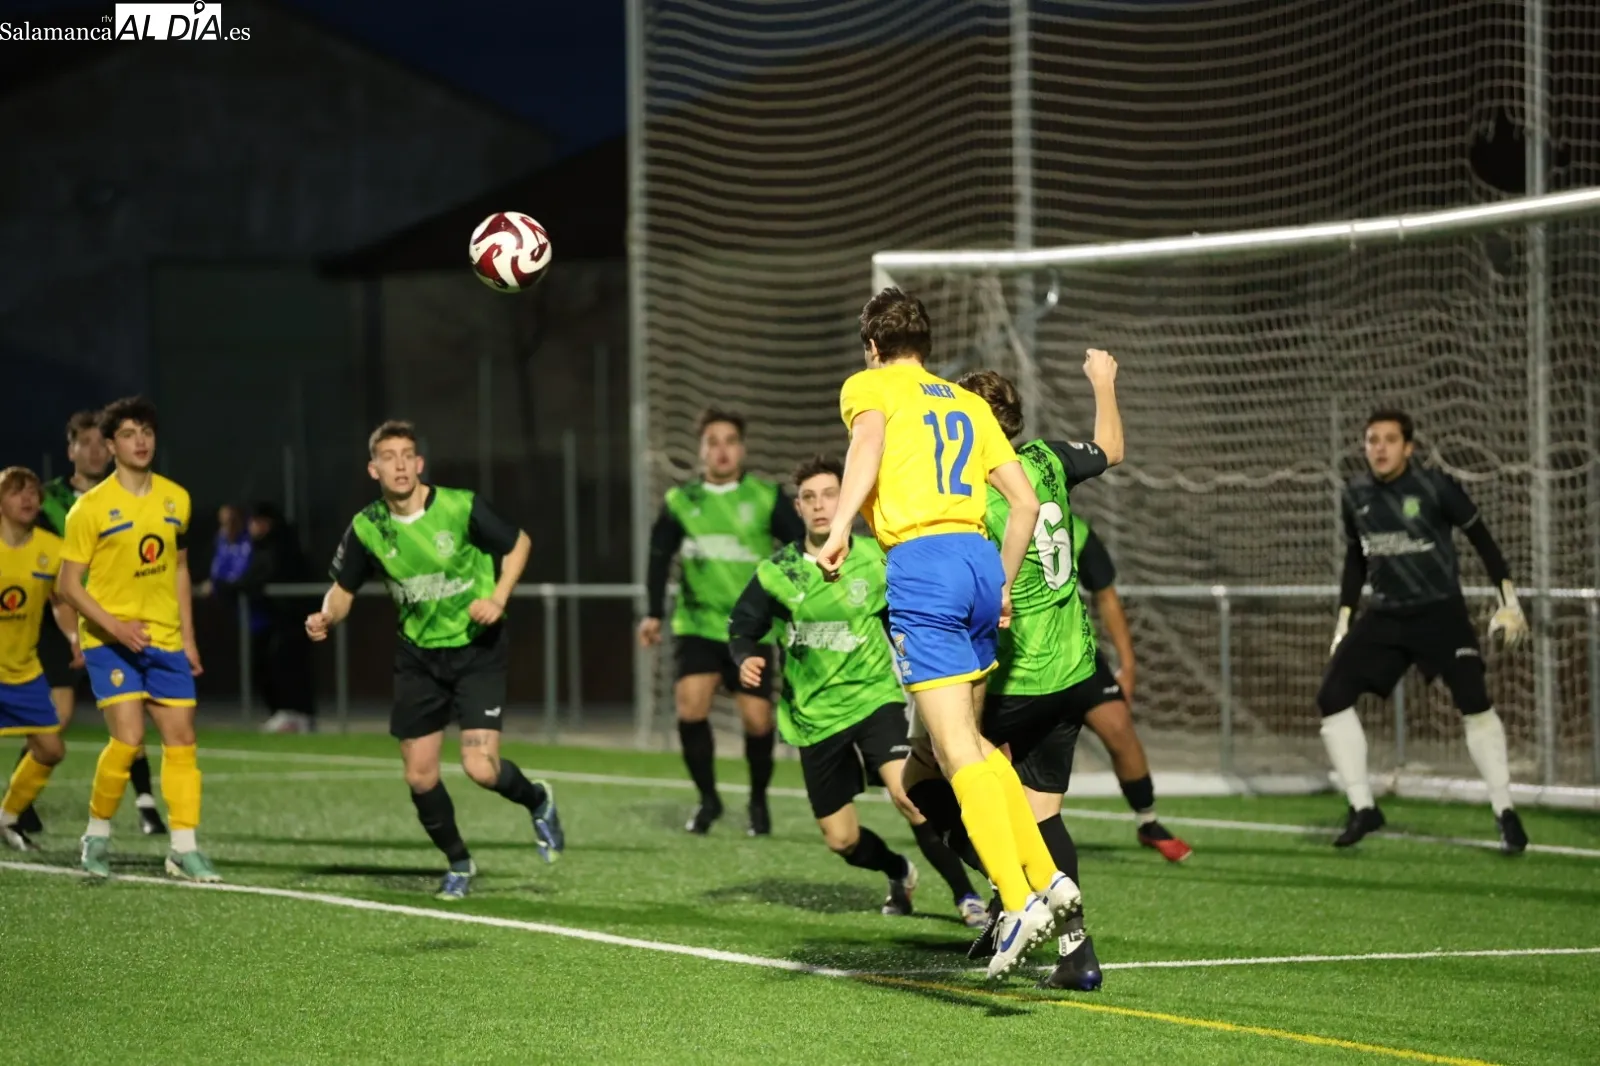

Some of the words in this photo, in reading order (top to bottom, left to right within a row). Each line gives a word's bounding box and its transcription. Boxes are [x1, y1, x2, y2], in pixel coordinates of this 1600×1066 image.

[918, 383, 956, 399] ANER
[923, 410, 974, 497] 12
[1034, 501, 1074, 591] 6
